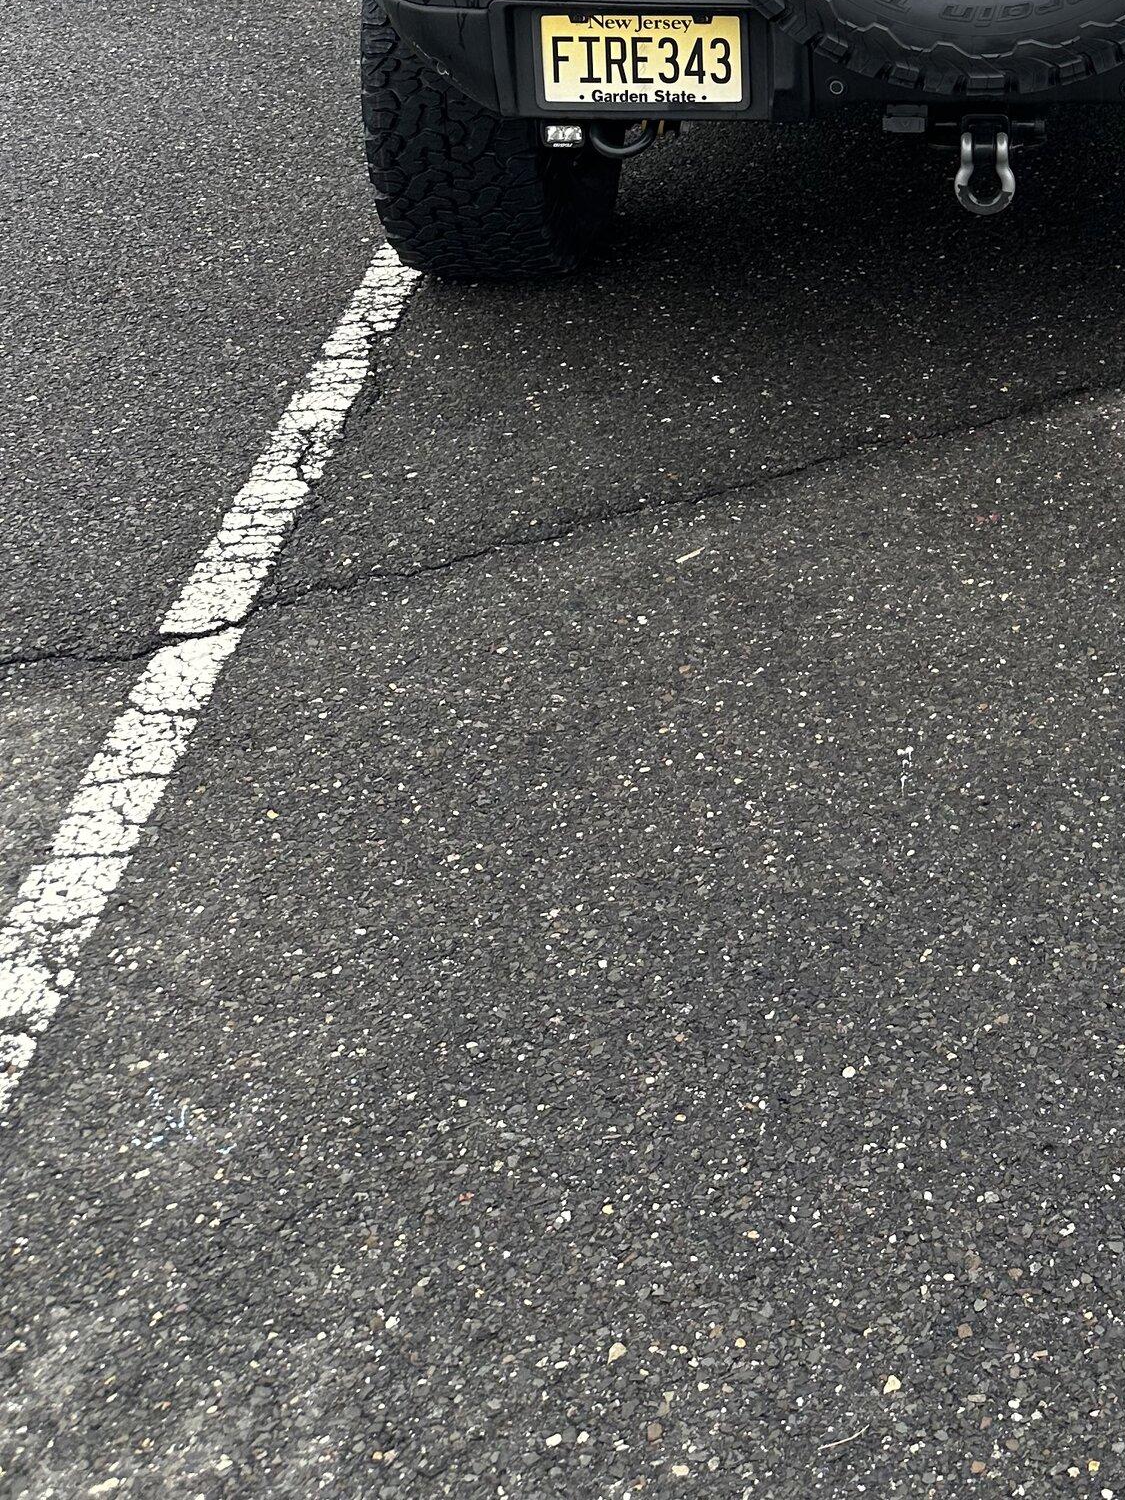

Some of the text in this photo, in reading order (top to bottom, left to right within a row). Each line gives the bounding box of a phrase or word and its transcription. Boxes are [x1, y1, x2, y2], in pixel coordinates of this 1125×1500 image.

[588, 15, 693, 33] New Jersey
[551, 36, 732, 85] FIRE343
[591, 89, 696, 103] Garden State
